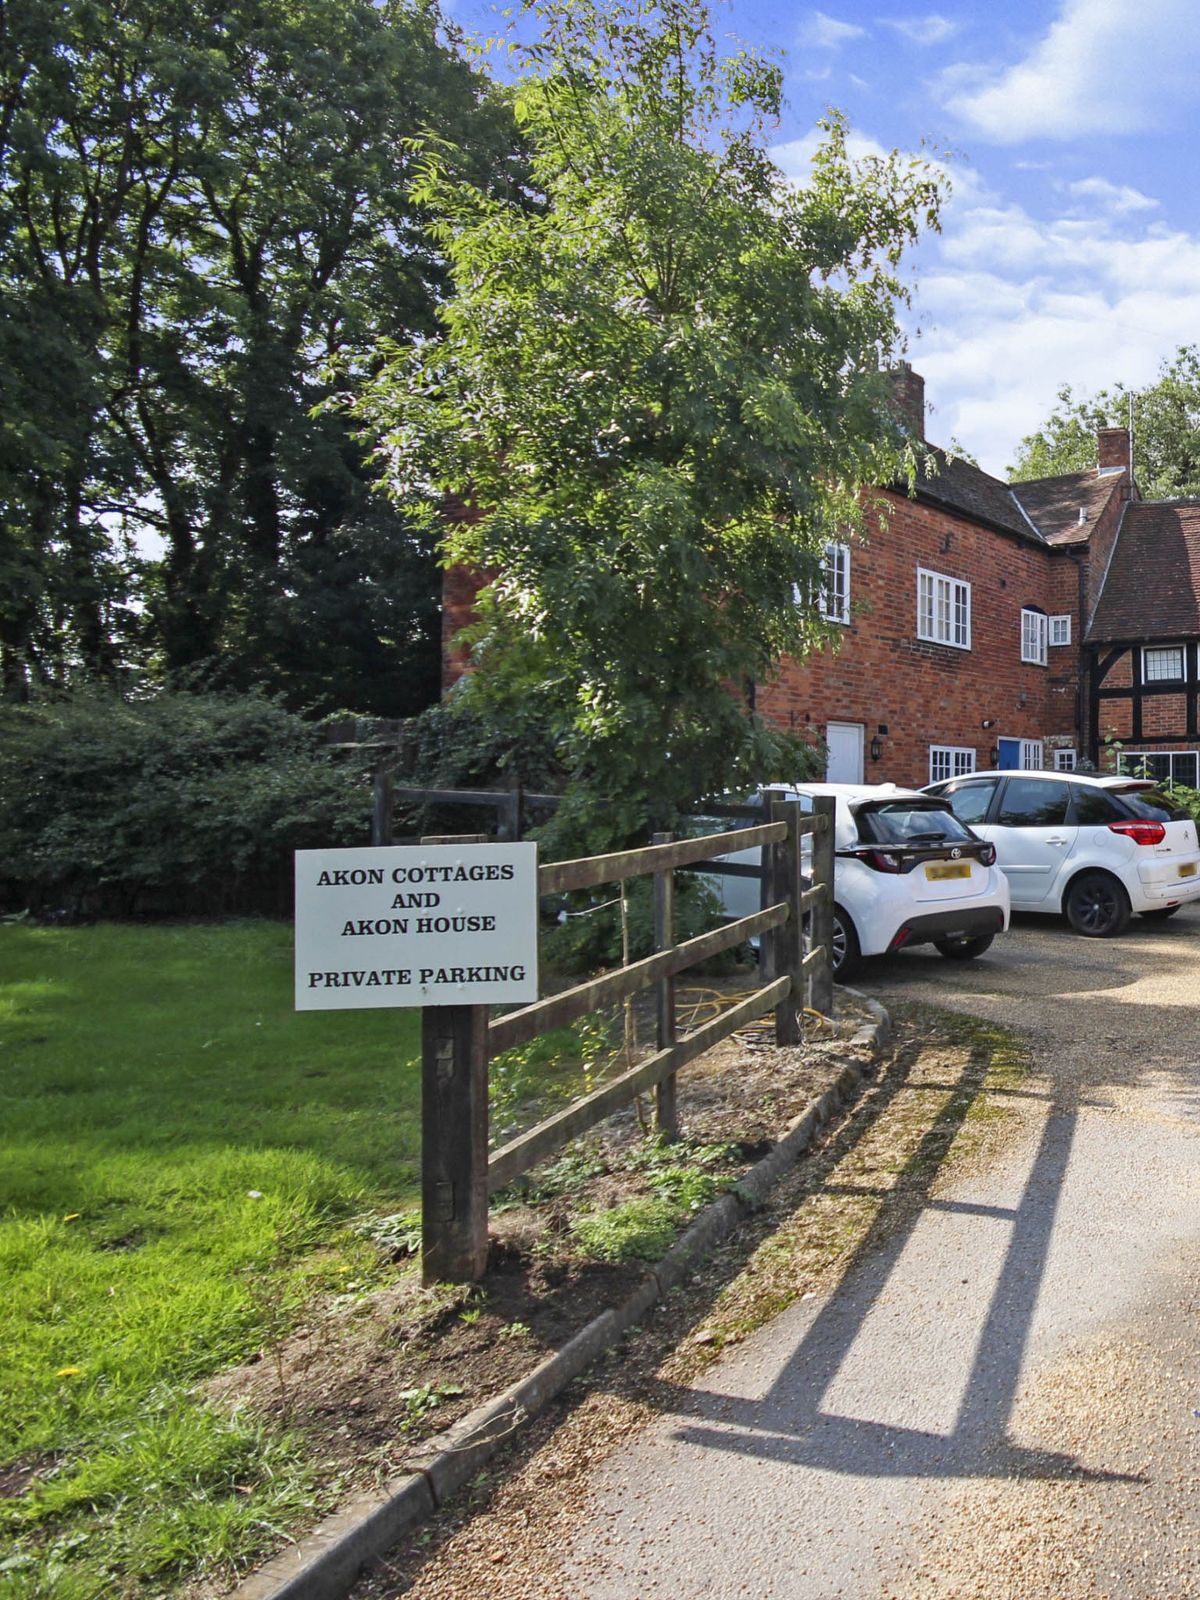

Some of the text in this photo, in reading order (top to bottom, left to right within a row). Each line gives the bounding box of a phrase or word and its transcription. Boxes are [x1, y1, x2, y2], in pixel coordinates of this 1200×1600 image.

[316, 864, 515, 886] AKON COTTAGES
[390, 892, 441, 909] AND
[341, 915, 496, 936] AKON HOUSE
[308, 965, 526, 988] PRIVATE PARKING
